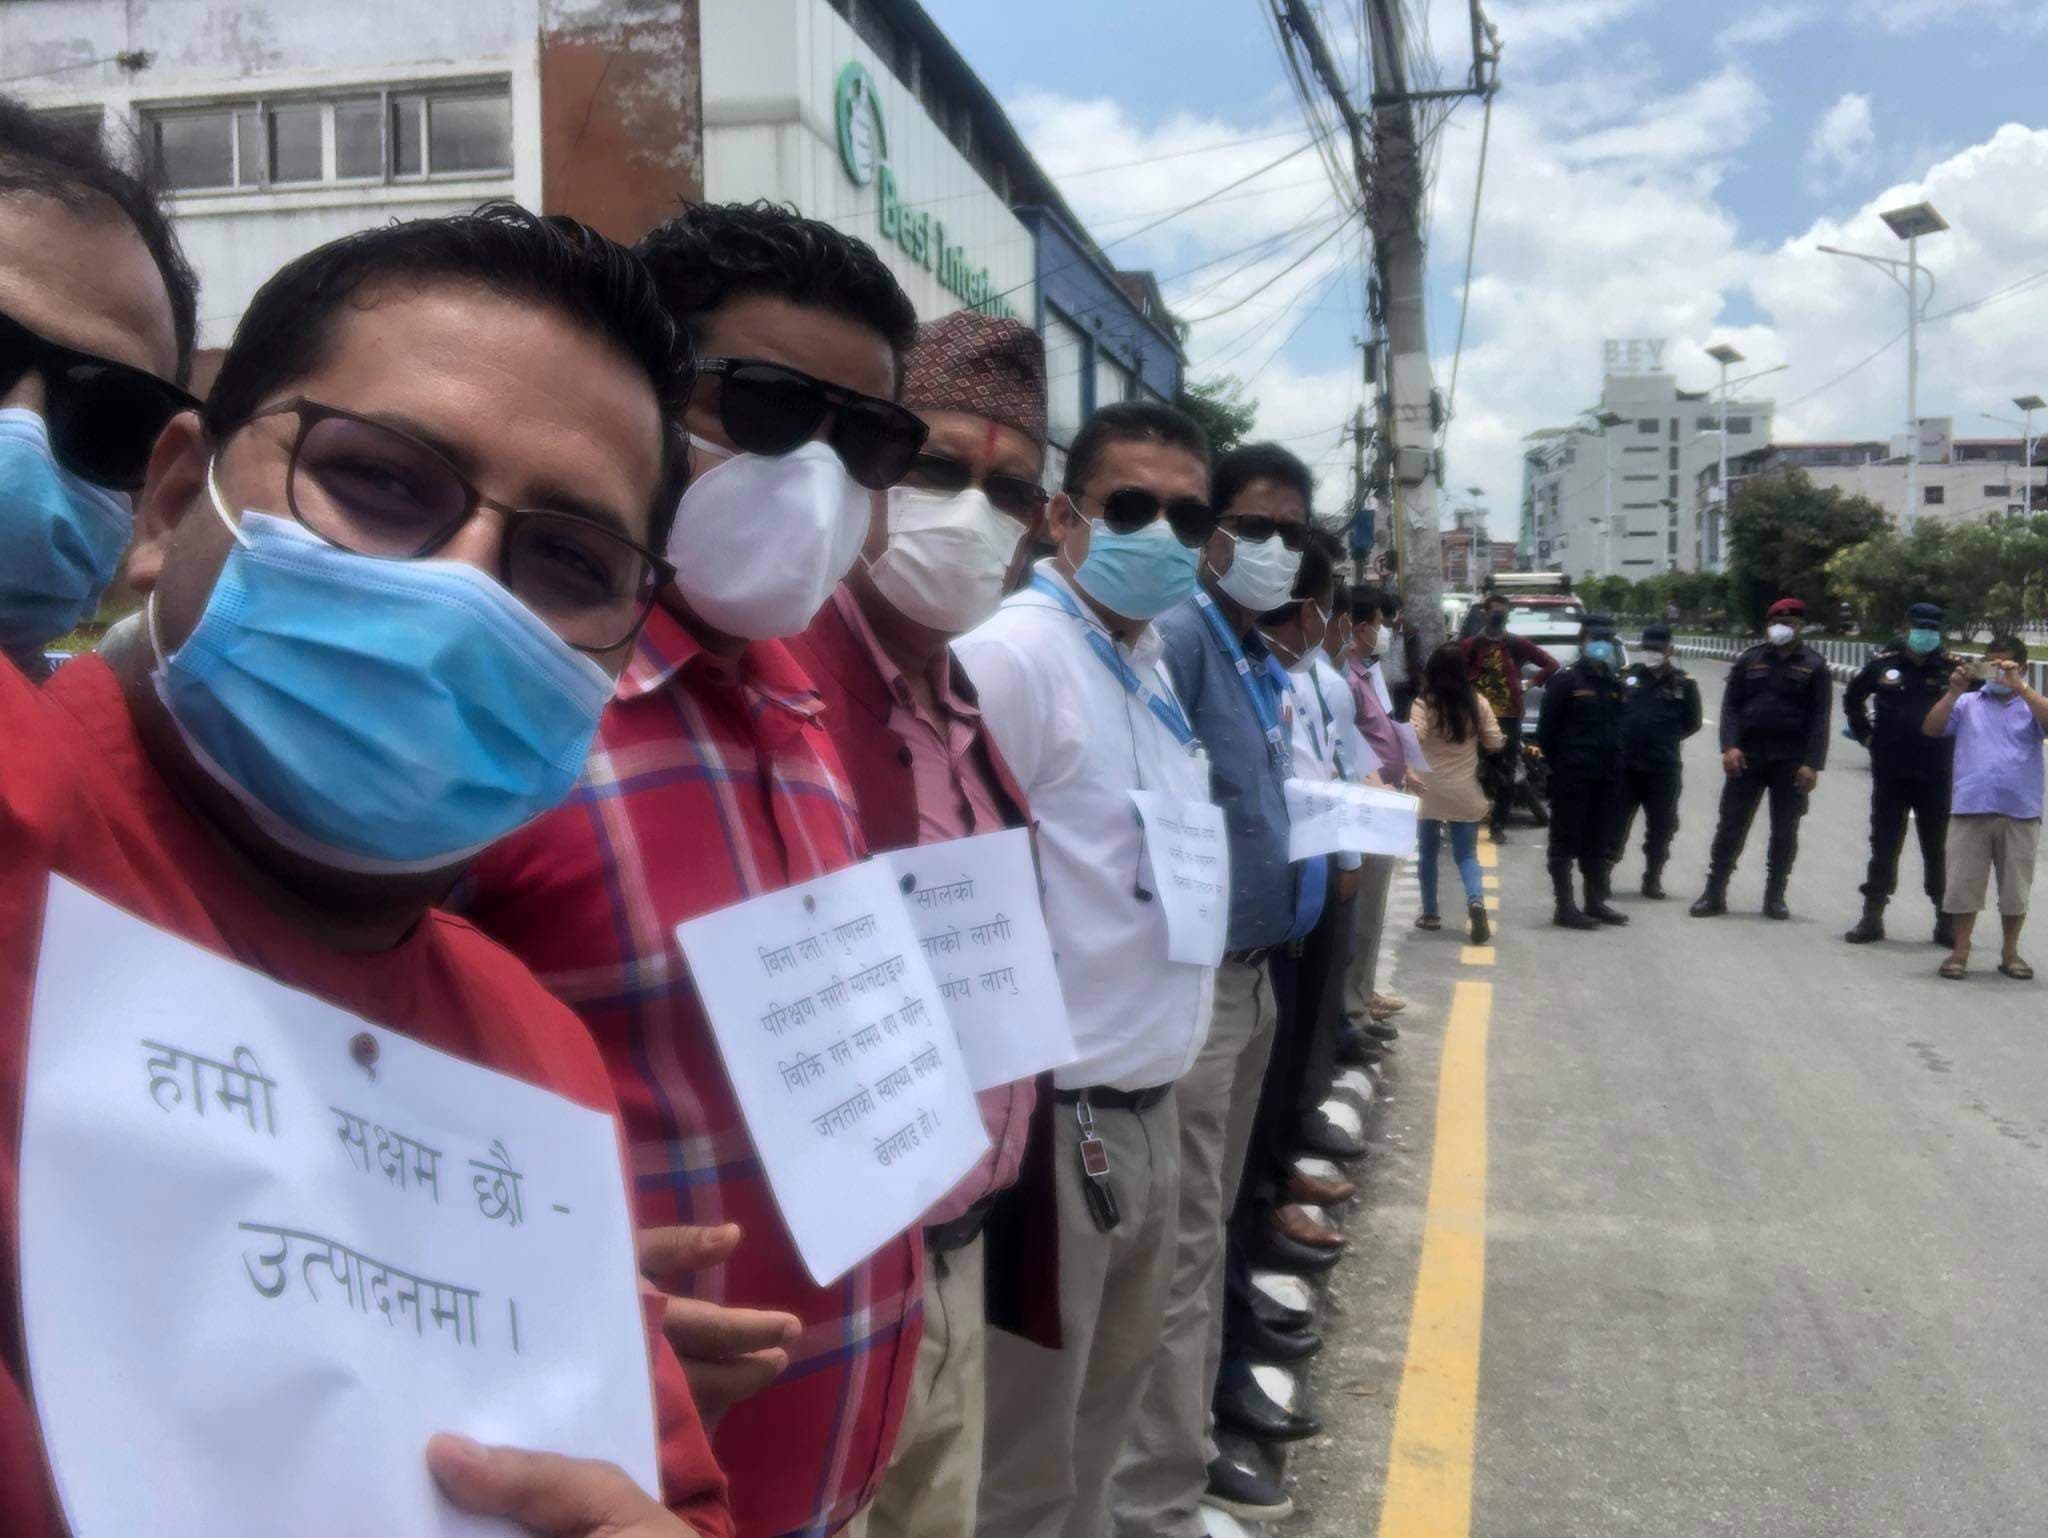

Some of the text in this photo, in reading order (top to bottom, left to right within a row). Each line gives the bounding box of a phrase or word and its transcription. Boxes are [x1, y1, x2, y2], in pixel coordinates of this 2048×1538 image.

[878, 164, 932, 273] Best
[913, 873, 974, 910] सालको
[969, 913, 1013, 945] लागी
[979, 966, 1019, 995] लागु
[760, 997, 817, 1038] परिक्षण
[141, 1038, 278, 1138] हामी
[329, 1105, 443, 1205] सक्षम
[811, 1084, 875, 1138] जनताको
[238, 1221, 481, 1347] उत्पादनमा
